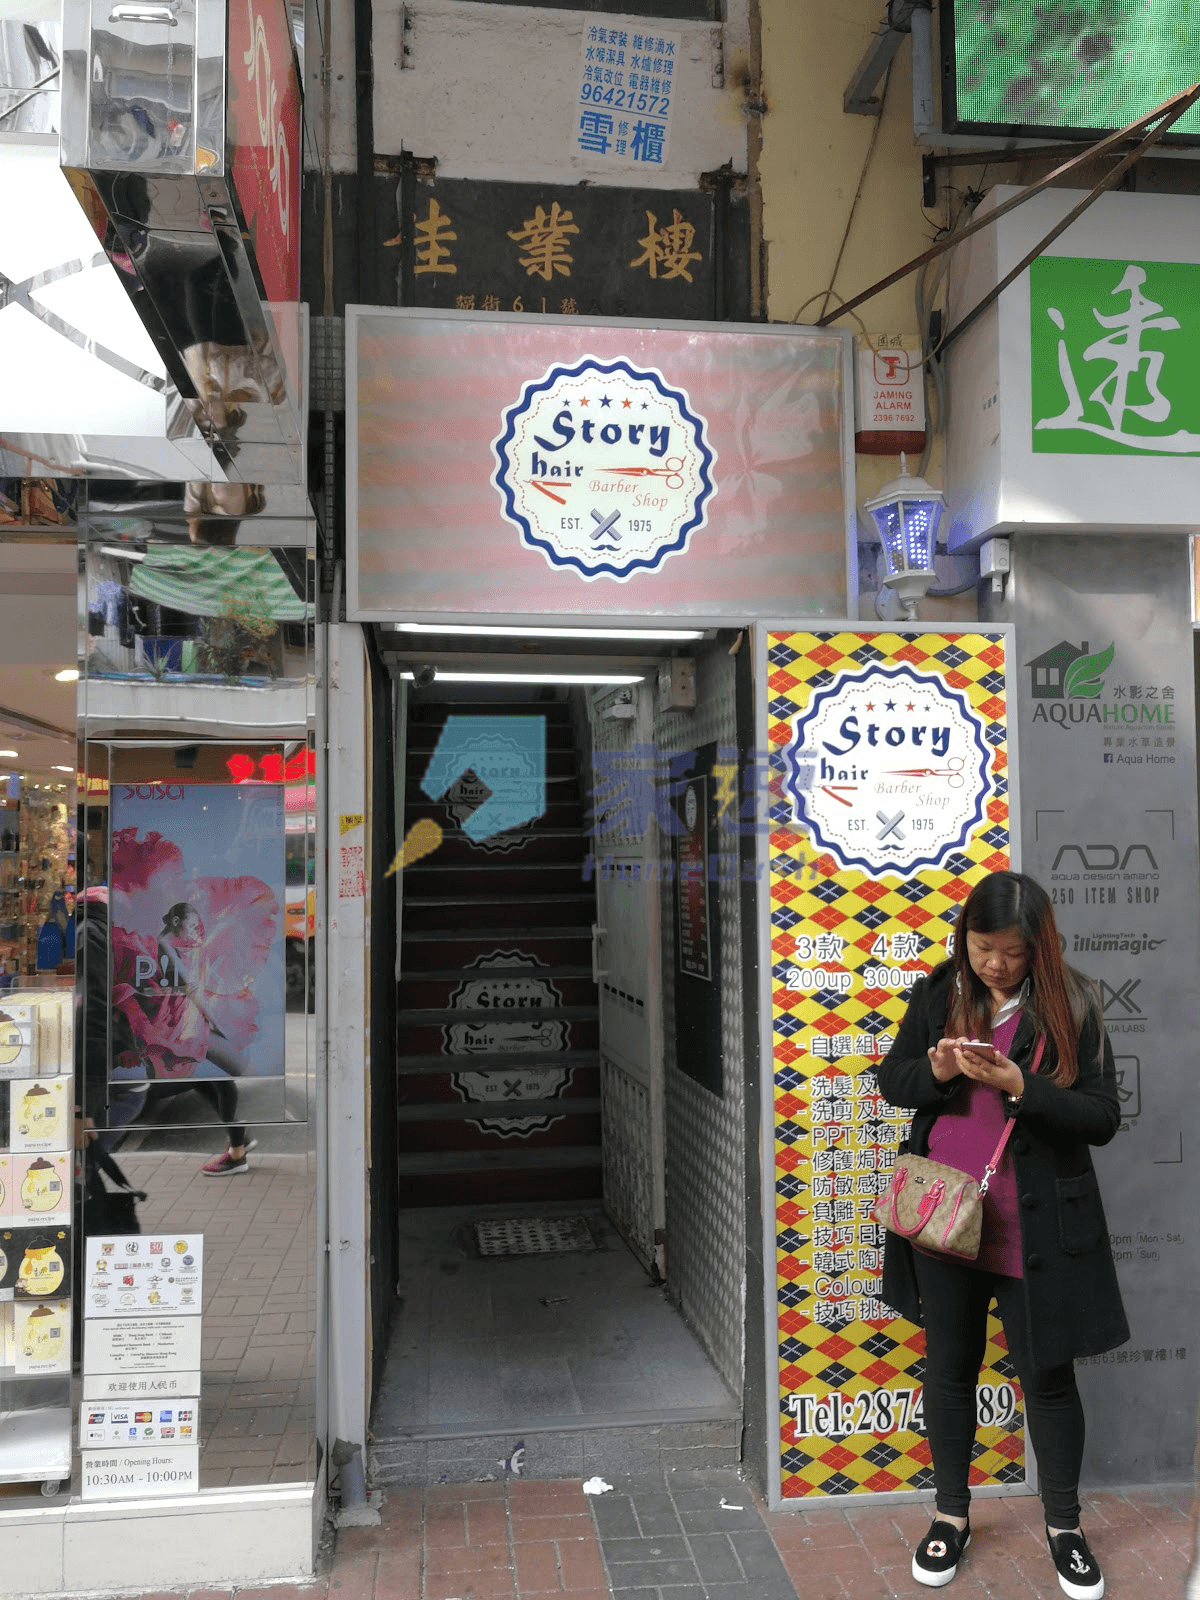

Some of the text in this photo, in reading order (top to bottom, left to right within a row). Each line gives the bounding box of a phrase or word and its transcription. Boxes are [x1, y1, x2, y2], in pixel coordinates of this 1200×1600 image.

[587, 25, 675, 56] 冷氣安裝 維修滴水
[585, 45, 674, 76] 水喉潔具 水爐修理
[582, 64, 672, 96] 冷氣改位 電器維修
[580, 82, 671, 116] 96421572
[577, 110, 614, 155] 雪
[630, 119, 666, 163] 櫃
[873, 391, 913, 400] JAMING
[875, 402, 912, 410] ALARM
[534, 410, 671, 458] Story
[531, 451, 584, 478] hair
[588, 479, 639, 494] Barber
[632, 493, 669, 511] Shop
[560, 517, 652, 532] EST. 1975
[1113, 685, 1175, 700] 水影之舍
[1032, 702, 1176, 730] AQUAHOME
[822, 715, 951, 758] Story
[1117, 754, 1176, 765] Aqua Home
[820, 757, 869, 781] hair
[873, 780, 922, 794] Barber
[916, 794, 950, 809] Shop
[848, 818, 934, 831] EST. 1975
[1051, 873, 1080, 881] aqua
[1085, 887, 1117, 904] ITEM
[1127, 887, 1160, 904] SHOP
[795, 936, 843, 959] 3款
[871, 934, 919, 958] 4款
[1073, 933, 1168, 955] illumagic
[787, 969, 851, 992] 200up
[1122, 1024, 1145, 1033] LABS
[464, 1031, 495, 1046] hair
[811, 1076, 882, 1096] 洗髮及
[814, 1251, 884, 1272] 韓式陶
[107, 1380, 178, 1392] 欢迎使用人民币
[124, 1458, 151, 1468] Opening
[152, 1457, 173, 1465] Hours:
